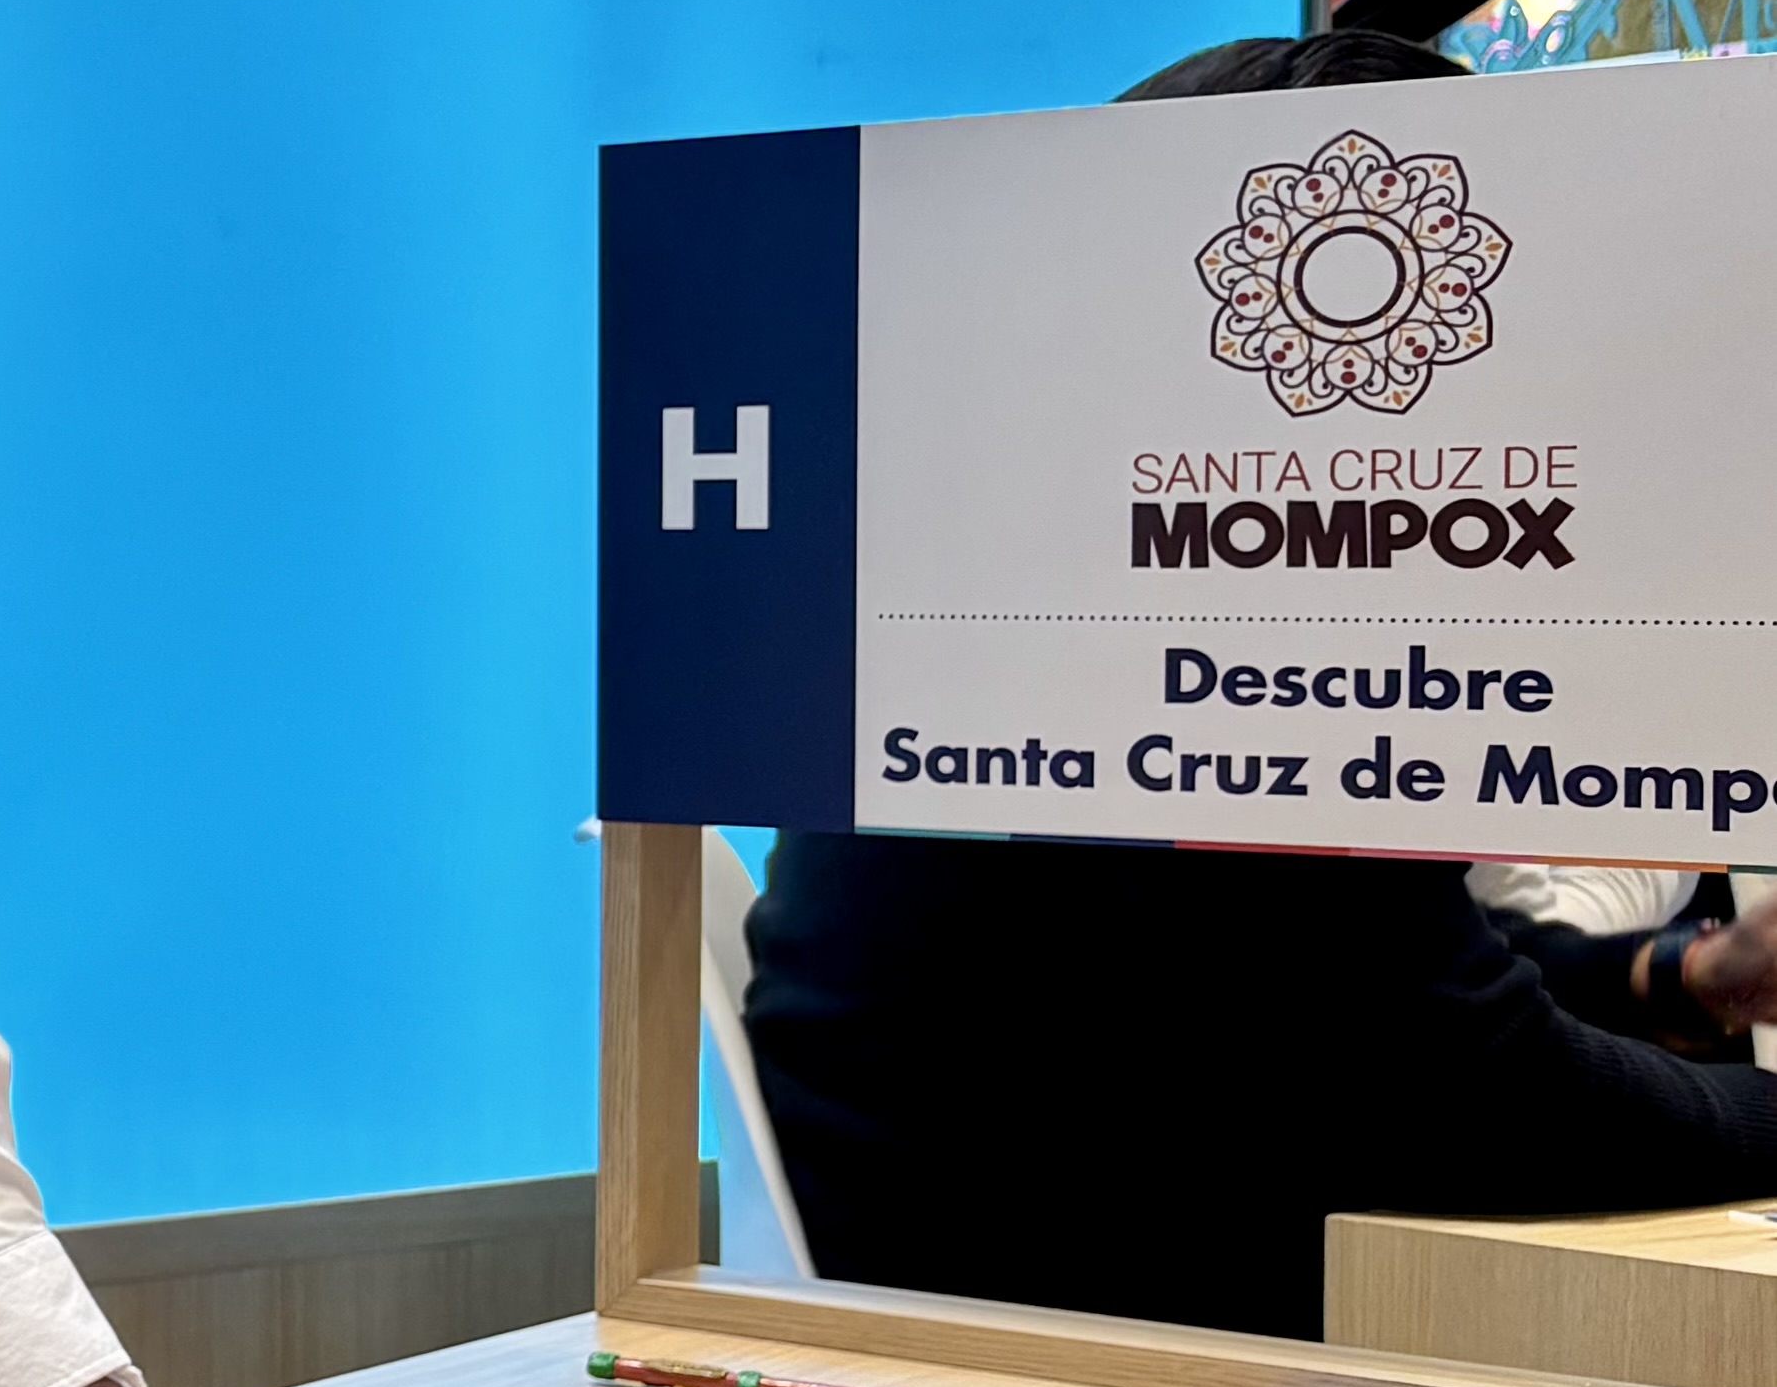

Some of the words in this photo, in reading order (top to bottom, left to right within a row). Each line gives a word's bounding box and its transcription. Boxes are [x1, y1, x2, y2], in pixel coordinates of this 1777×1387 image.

[661, 404, 770, 531] H
[1132, 450, 1312, 494] SANTA
[1329, 447, 1483, 492] CRUZ
[1503, 444, 1579, 490] DE
[1131, 497, 1576, 570] MOMPOX
[1164, 644, 1554, 713] Descubre
[881, 727, 1096, 789] Santa
[1126, 733, 1310, 797] Cruz
[1340, 735, 1446, 802] de
[1476, 743, 1777, 833] Momp
